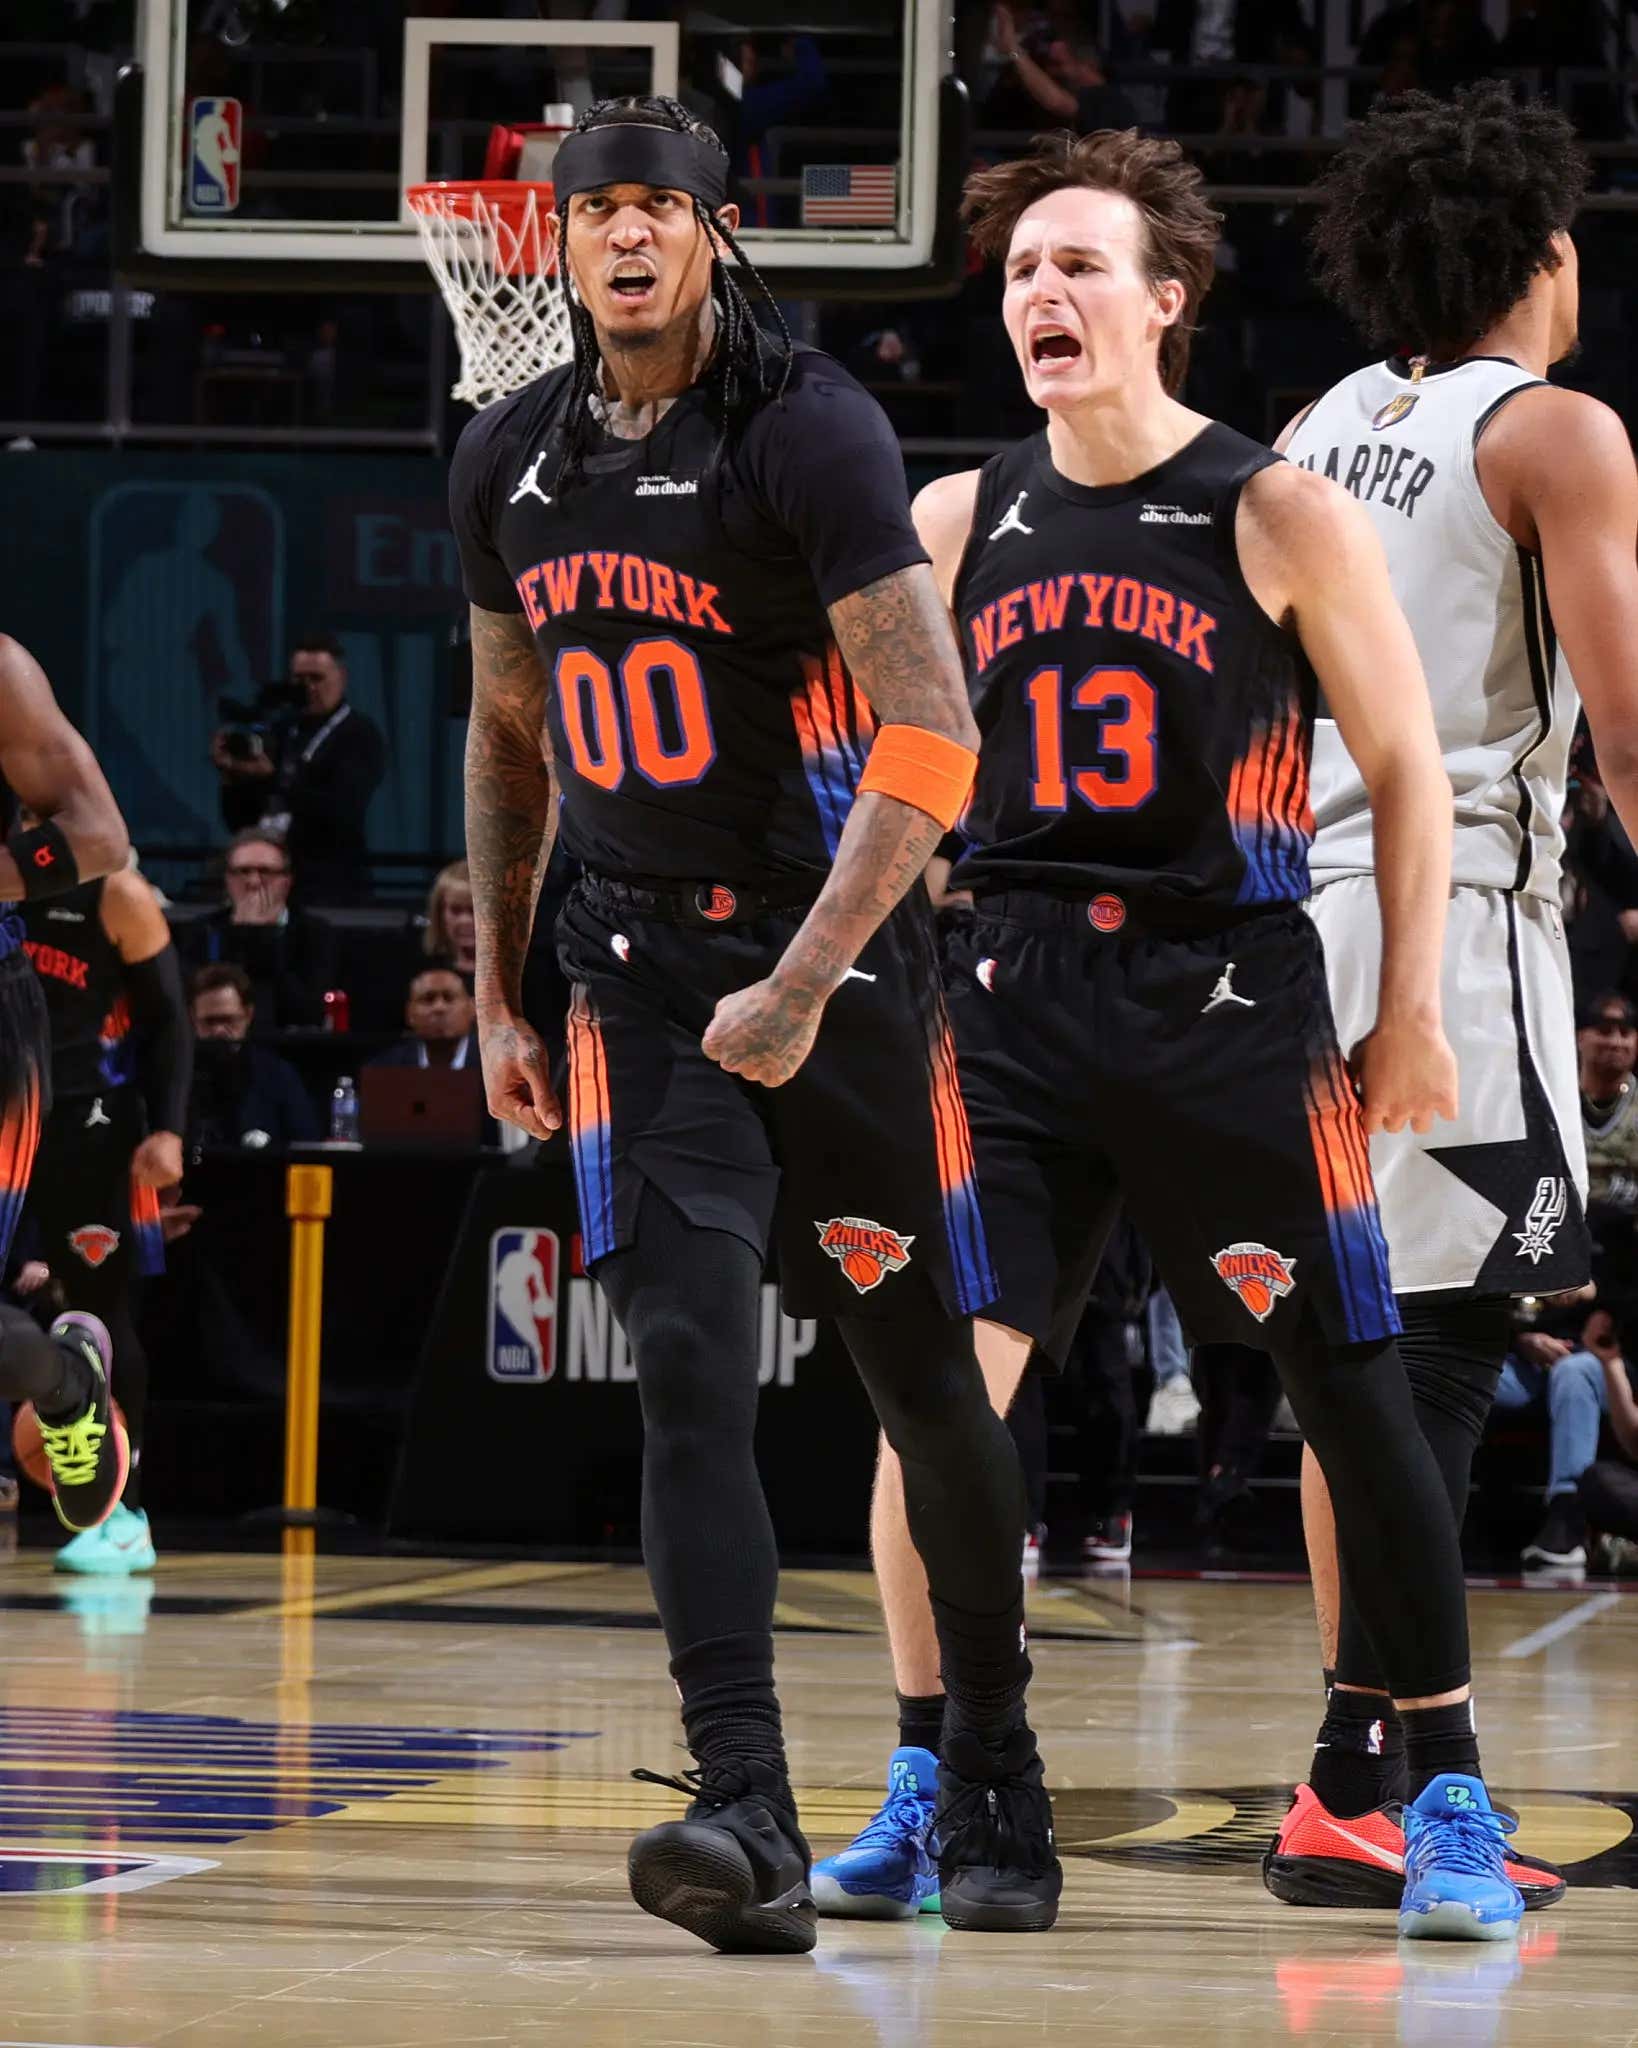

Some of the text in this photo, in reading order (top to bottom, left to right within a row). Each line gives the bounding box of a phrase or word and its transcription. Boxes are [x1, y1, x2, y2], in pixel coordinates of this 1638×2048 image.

[635, 480, 698, 495] abu dhabi
[1298, 443, 1434, 519] ARPER
[1139, 510, 1213, 525] abu dhabi
[515, 551, 734, 634] EW YORK
[970, 572, 1218, 675] NEW YORK
[554, 635, 717, 790] 00
[1024, 664, 1158, 812] 13
[822, 1220, 908, 1261] KNICKS
[1218, 1252, 1292, 1285] KNICKS
[498, 1347, 531, 1371] NBA
